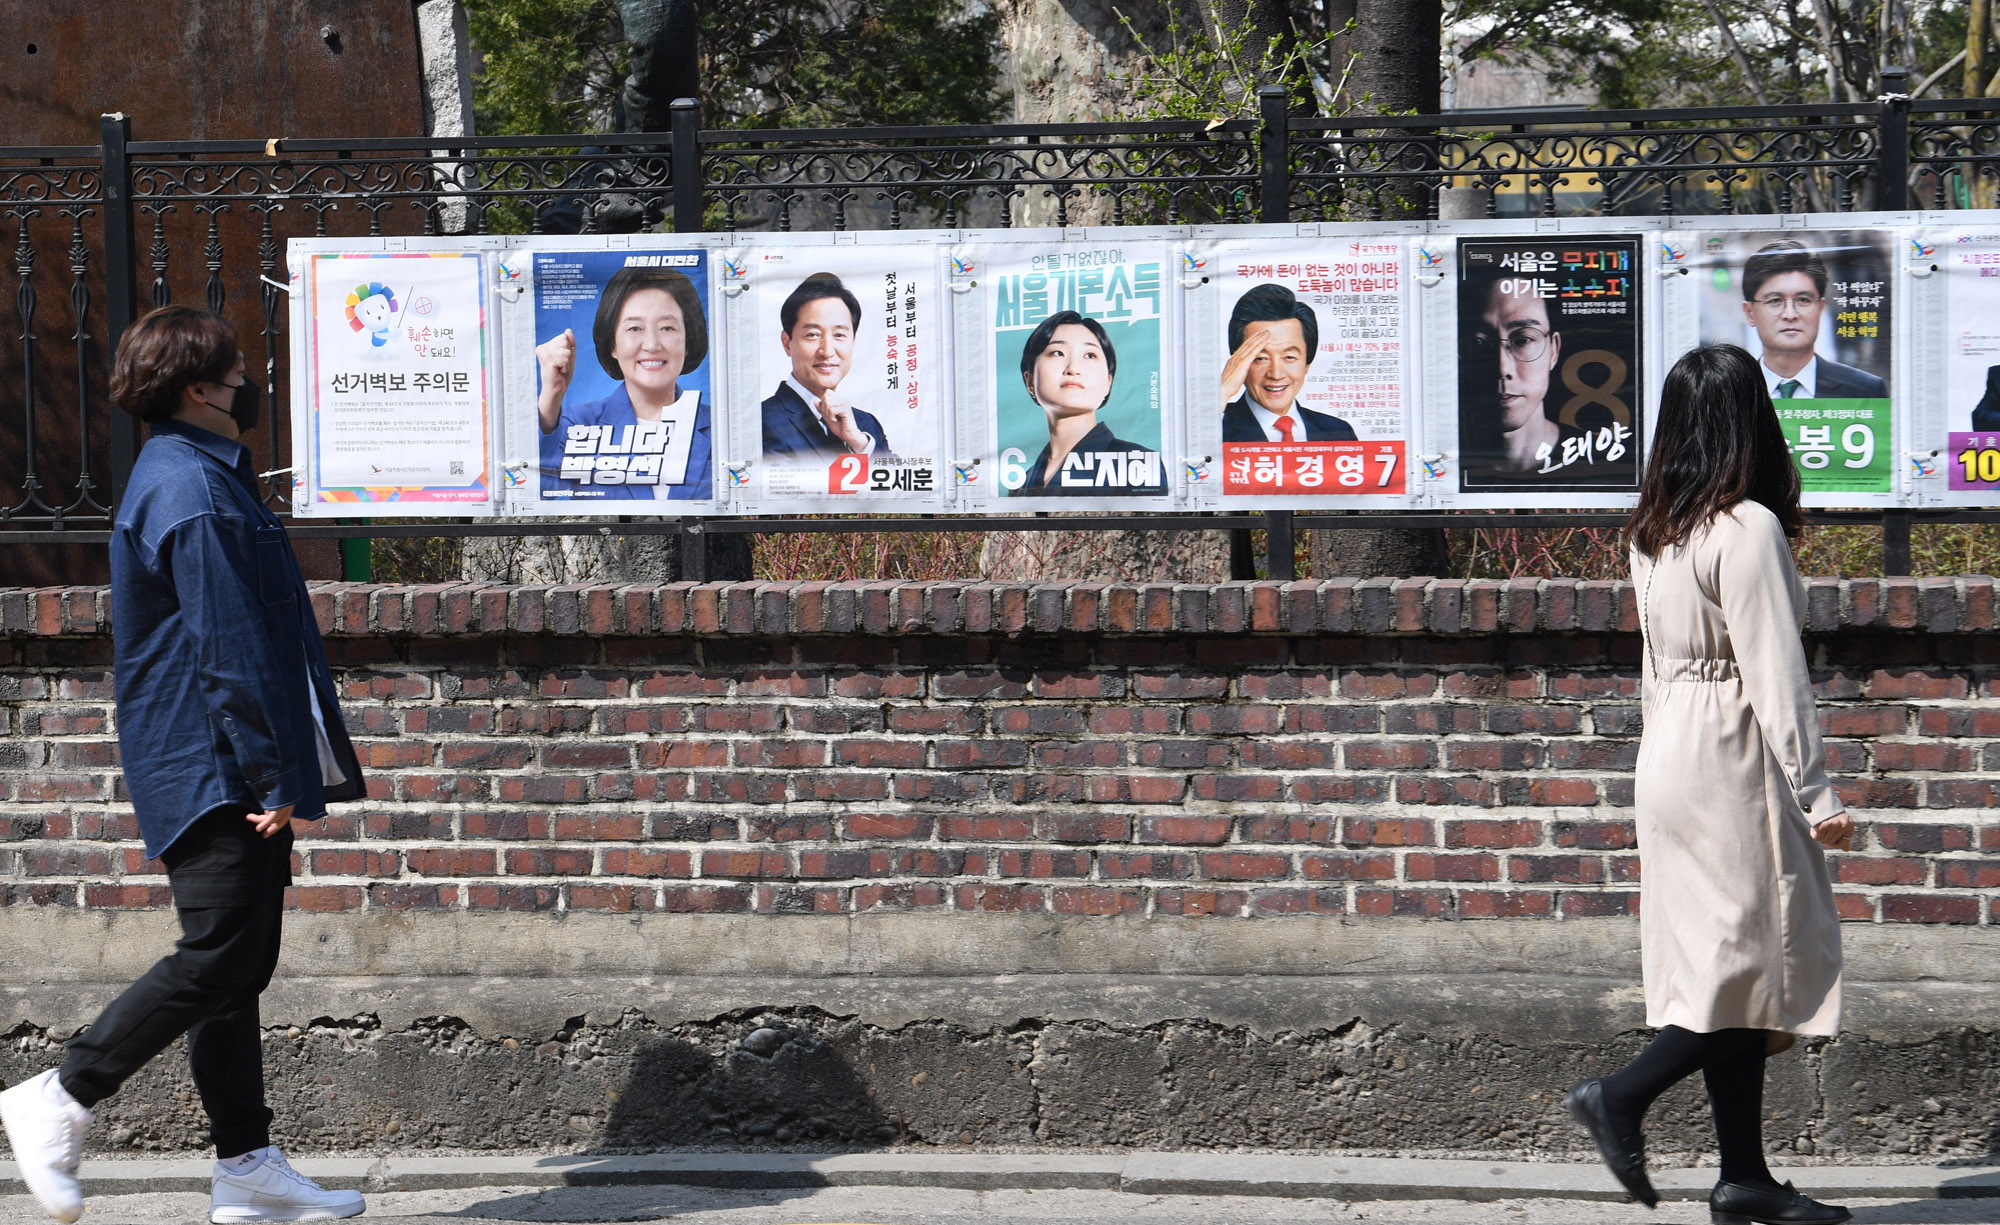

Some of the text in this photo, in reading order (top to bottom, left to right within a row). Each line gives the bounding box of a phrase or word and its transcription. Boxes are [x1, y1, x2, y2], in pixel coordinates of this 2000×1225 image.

[624, 255, 699, 268] 서울시 대전환
[1237, 262, 1398, 278] 국가에 돈이 없는 것이 아니라
[1500, 250, 1629, 272] 서울은 무지개
[996, 262, 1160, 328] 서울기본소득
[1297, 278, 1398, 293] 도둑놈이 많습니다
[1500, 278, 1629, 299] 이기는 소수자
[905, 282, 917, 338] 서울부터
[1314, 295, 1332, 304] 국가
[1332, 306, 1367, 316] 허경영이
[1339, 317, 1347, 327] 그
[1379, 317, 1388, 327] 그
[1836, 311, 1879, 323] 서민 행복
[408, 325, 454, 342] 훼손하면
[885, 271, 899, 390] 첫날부터 능숙하게
[1341, 329, 1359, 338] 이제
[1836, 325, 1878, 338] 서울 혁명
[415, 344, 456, 358] 안 돼요!
[1320, 343, 1343, 352] 서울시
[331, 372, 470, 393] 선거벽보 주의문
[1559, 349, 1631, 436] 8
[564, 424, 670, 454] 합니다
[660, 390, 702, 485] 1
[1535, 421, 1633, 474] 오태양
[1785, 424, 1875, 469] 봉 9
[560, 456, 664, 485] 박영선
[840, 456, 861, 492] 2
[999, 447, 1027, 490] 6
[1061, 450, 1161, 487] 신지혜
[1374, 455, 1397, 487] 7
[1958, 448, 2000, 483] 10
[870, 468, 933, 492] 오세훈
